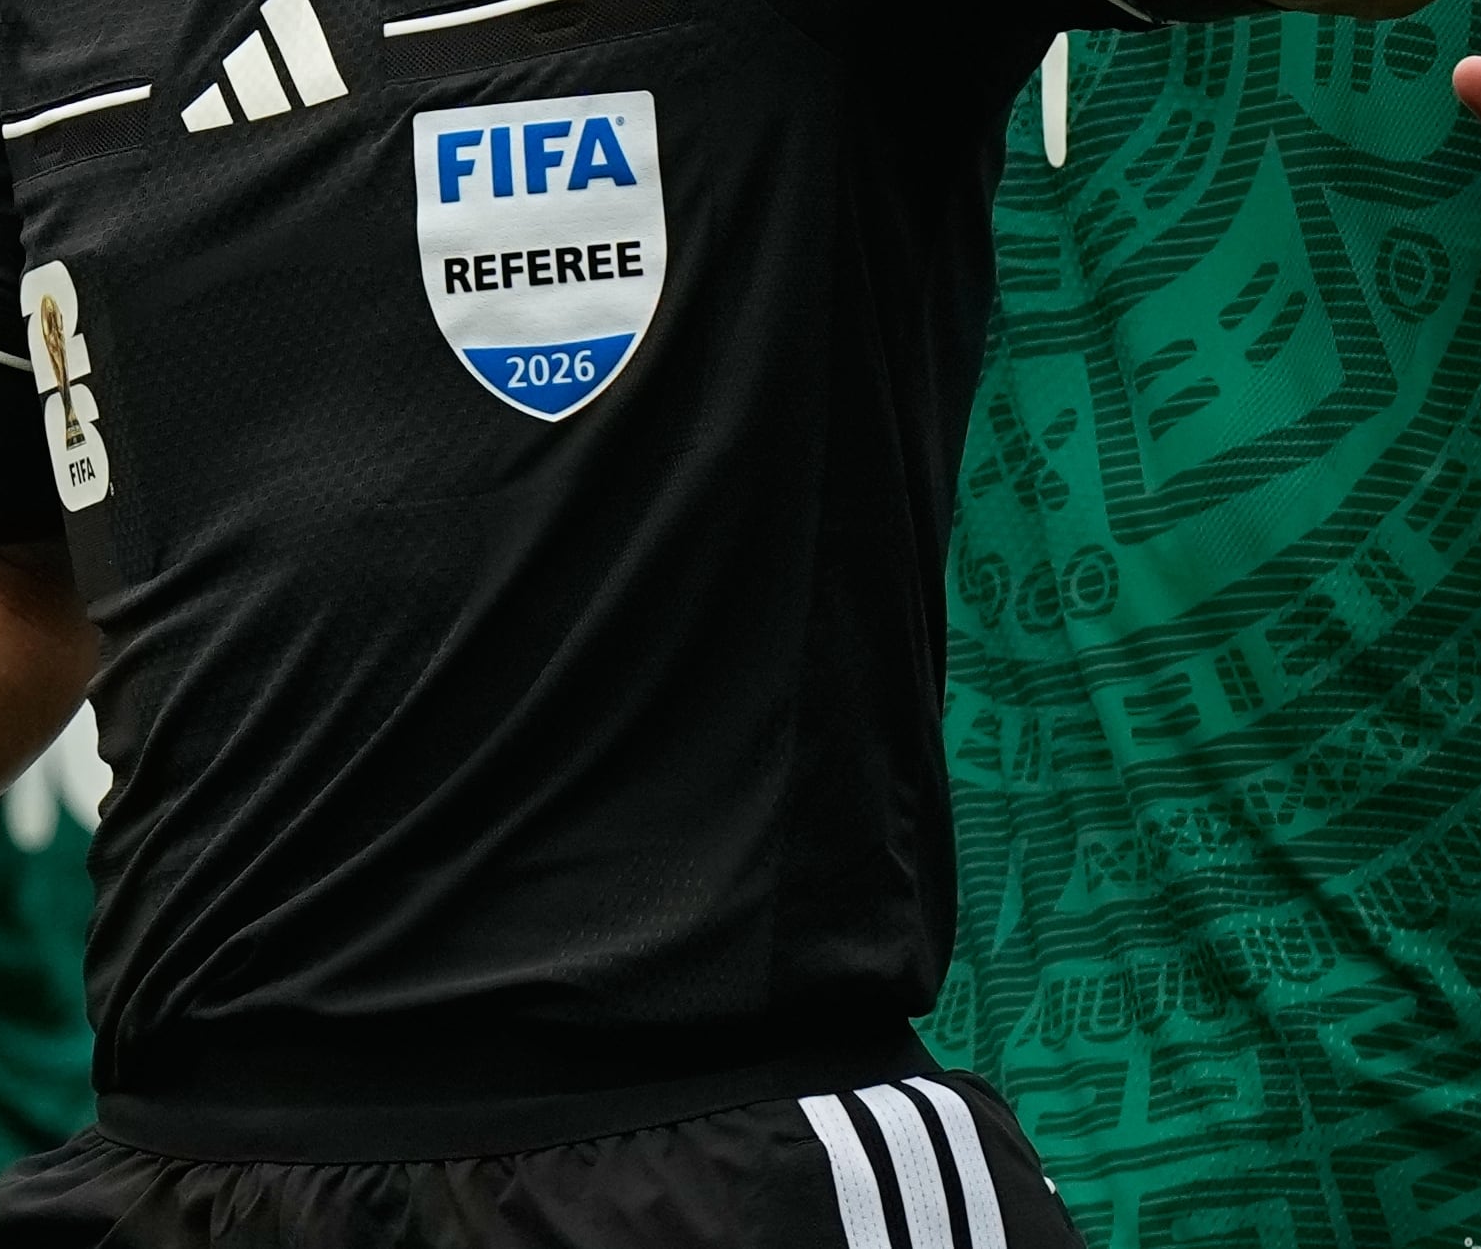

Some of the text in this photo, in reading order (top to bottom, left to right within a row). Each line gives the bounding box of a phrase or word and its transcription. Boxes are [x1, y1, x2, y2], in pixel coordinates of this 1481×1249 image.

[437, 117, 637, 204] FIFA
[444, 241, 643, 294] REFEREE
[506, 350, 595, 388] 2026
[68, 456, 96, 487] FIFA
